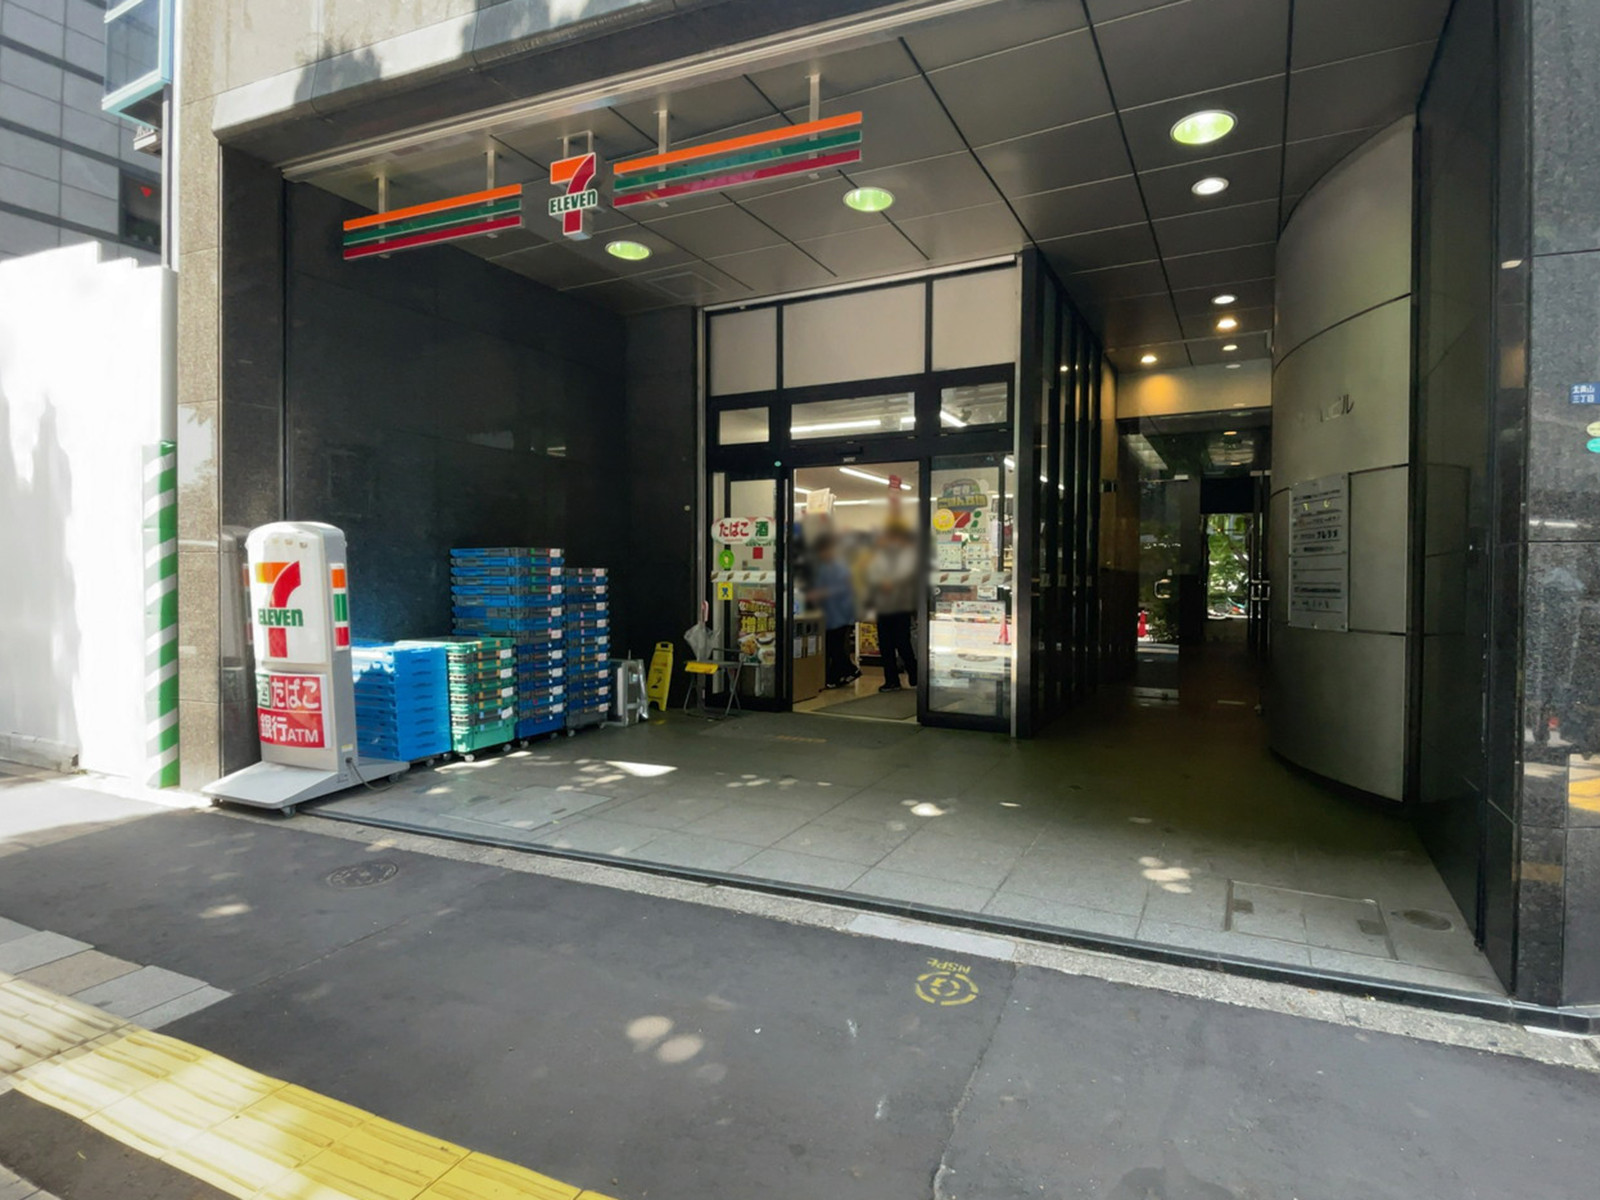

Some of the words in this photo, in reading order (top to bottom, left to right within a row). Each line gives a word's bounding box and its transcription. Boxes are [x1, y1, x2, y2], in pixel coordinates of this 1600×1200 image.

[550, 152, 597, 236] 7
[719, 521, 750, 537] たばこ
[754, 520, 769, 537] 酒
[271, 676, 320, 710] たばこ
